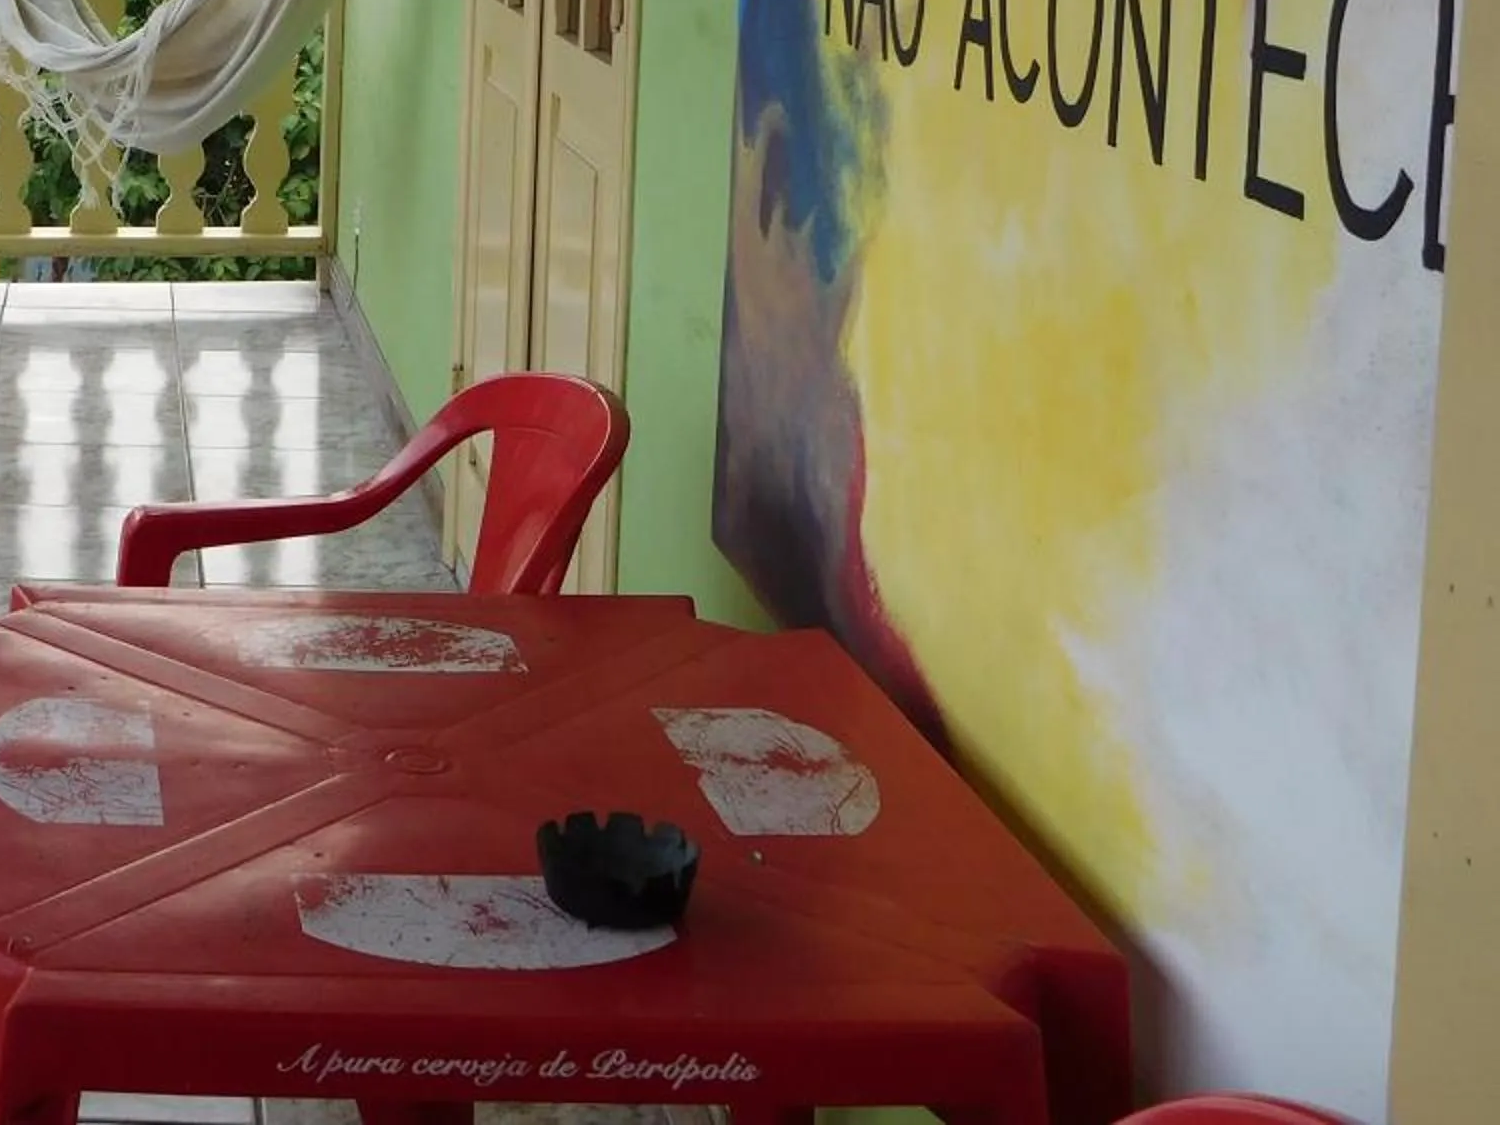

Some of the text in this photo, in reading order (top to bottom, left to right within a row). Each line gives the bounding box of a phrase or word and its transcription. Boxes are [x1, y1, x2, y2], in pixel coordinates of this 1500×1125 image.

[276, 1042, 759, 1091] A pura cerveja de Petrópolis
